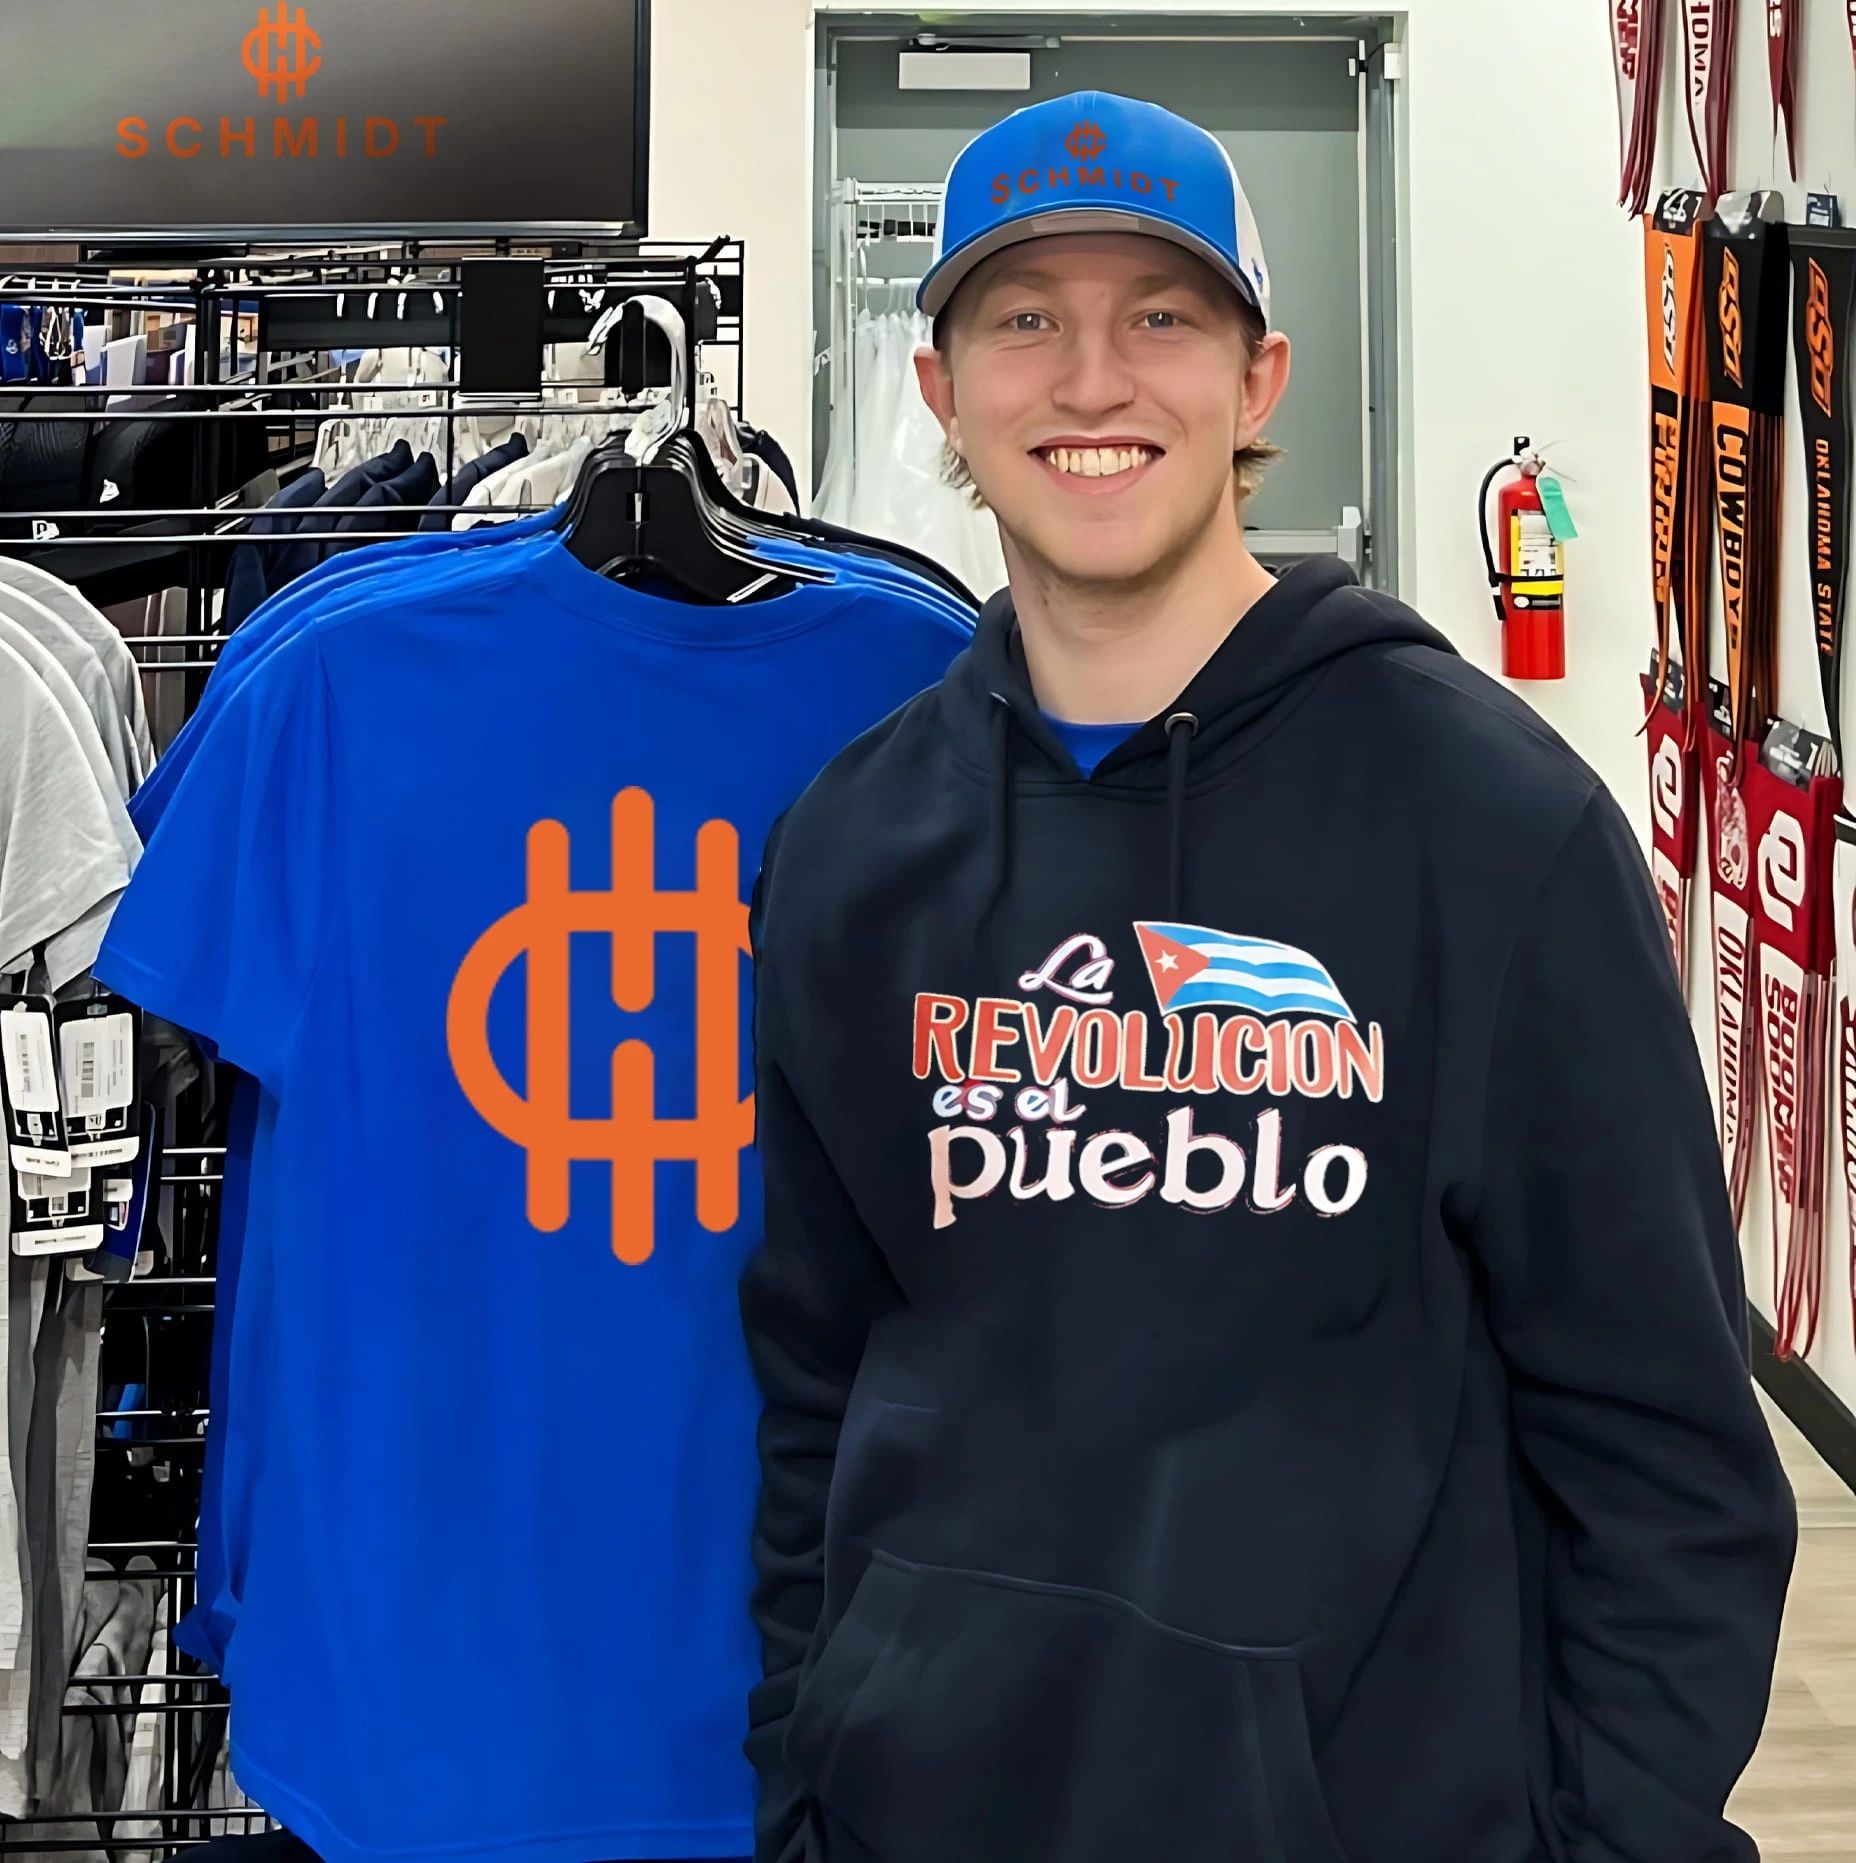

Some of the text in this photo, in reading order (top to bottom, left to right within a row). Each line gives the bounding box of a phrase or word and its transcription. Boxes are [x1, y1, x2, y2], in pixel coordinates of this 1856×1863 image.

[115, 116, 448, 158] SCHMIDT
[991, 166, 1181, 204] SCHMIDT
[1017, 932, 1115, 1005] La
[911, 992, 1385, 1103] REVOLUCION
[931, 1078, 1088, 1122] es el
[927, 1105, 1368, 1230] pueblo
